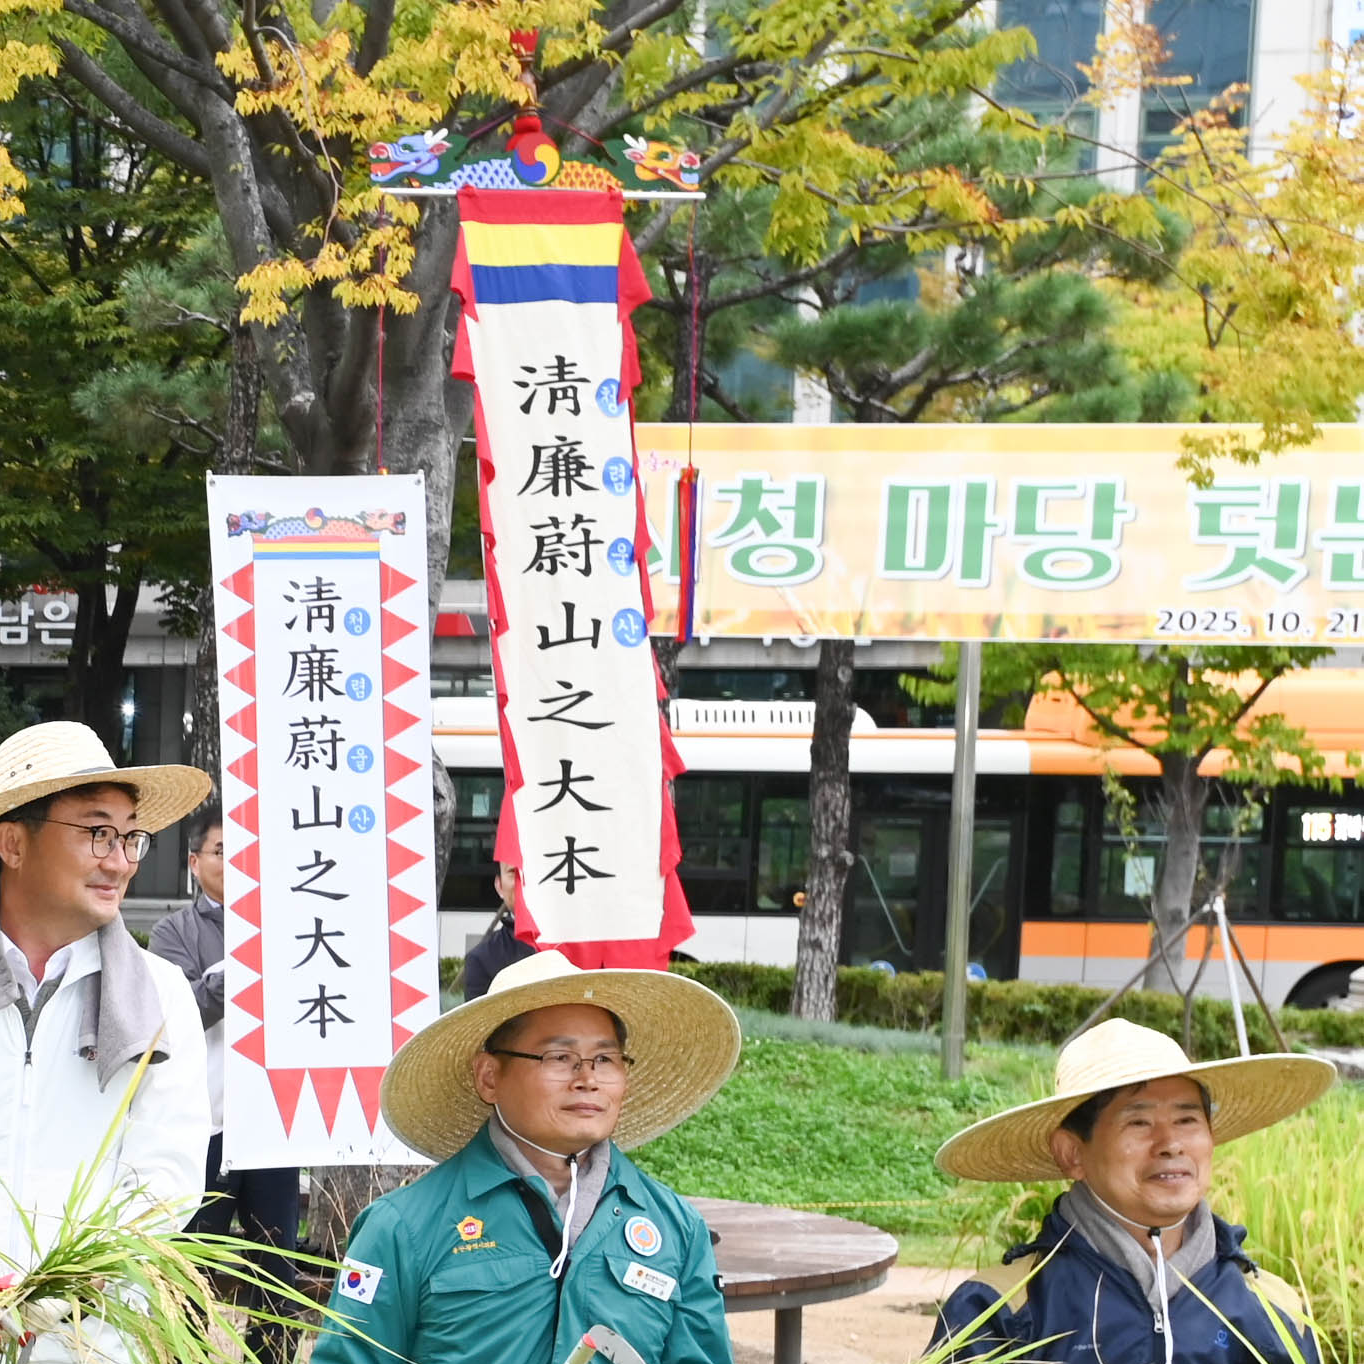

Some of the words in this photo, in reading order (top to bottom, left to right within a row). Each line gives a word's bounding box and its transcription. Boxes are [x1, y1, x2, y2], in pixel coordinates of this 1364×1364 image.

[647, 478, 821, 579] 청
[883, 479, 1127, 583] 마당
[1158, 610, 1248, 632] 2025.
[1268, 612, 1311, 634] 10.
